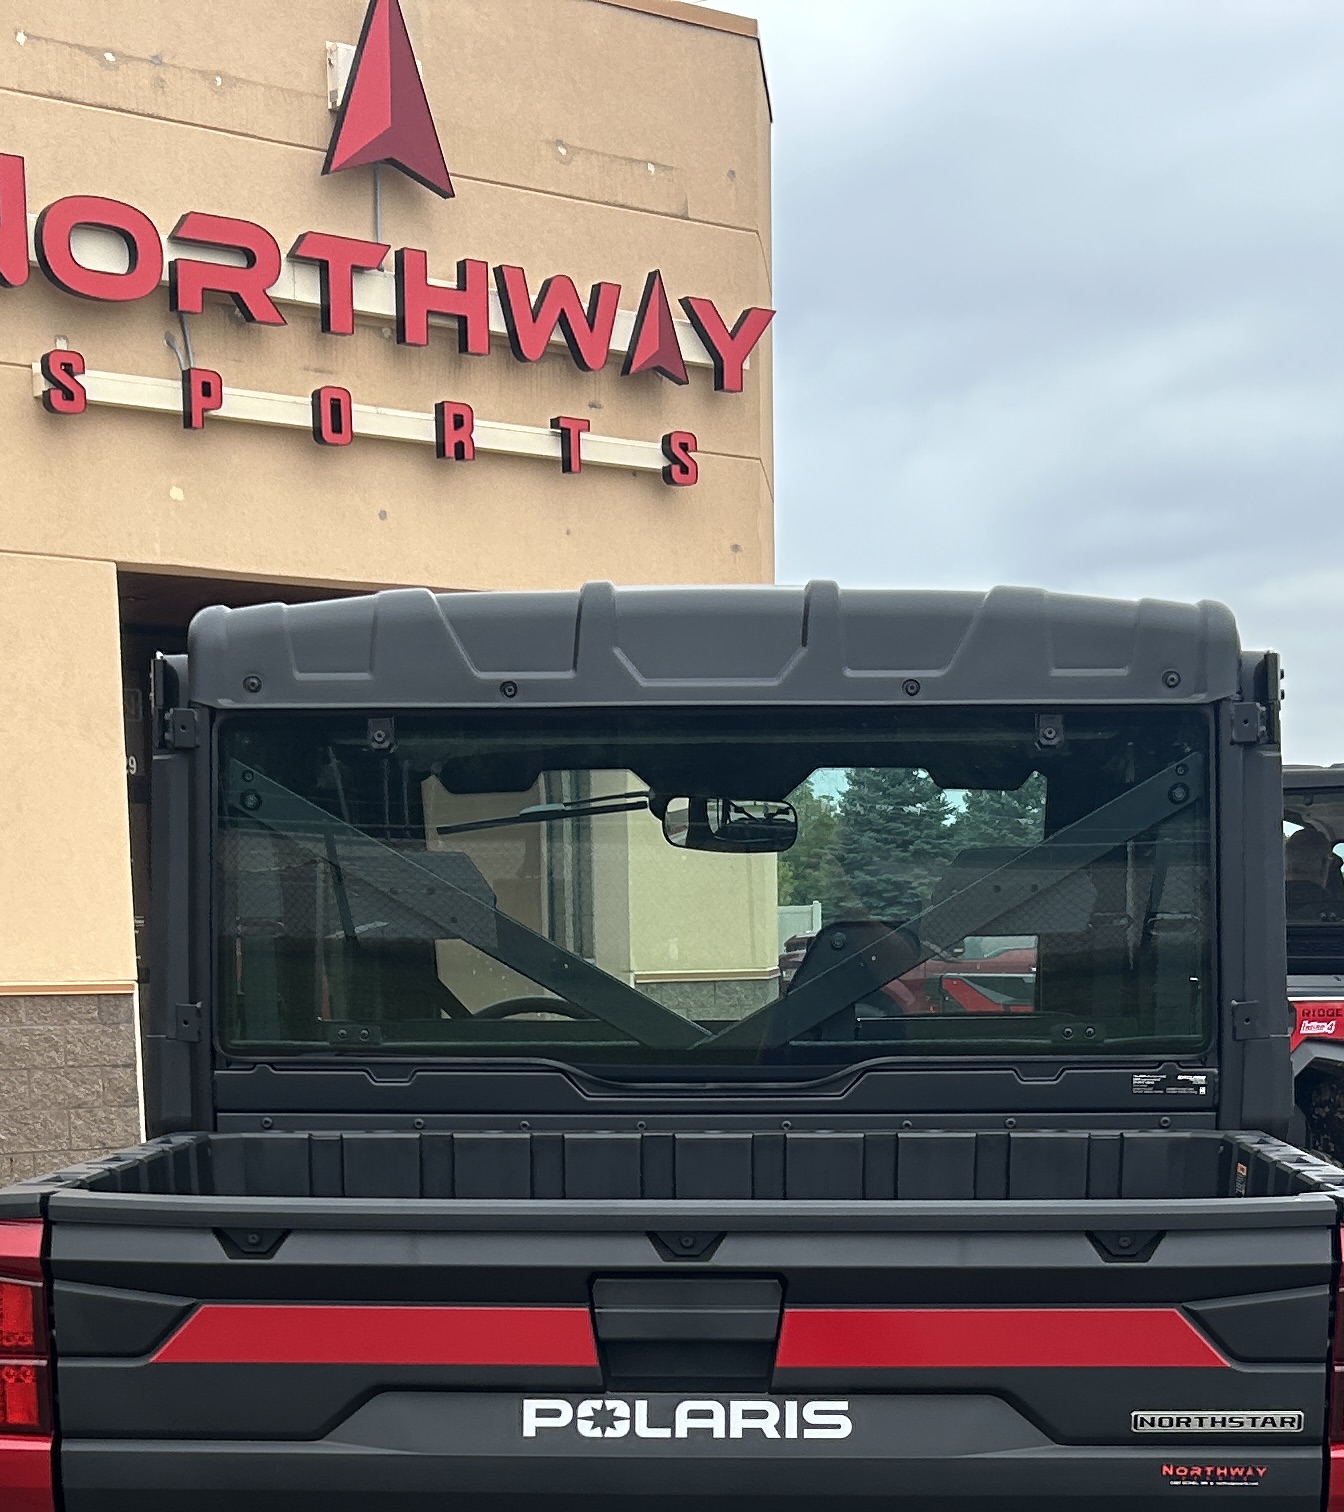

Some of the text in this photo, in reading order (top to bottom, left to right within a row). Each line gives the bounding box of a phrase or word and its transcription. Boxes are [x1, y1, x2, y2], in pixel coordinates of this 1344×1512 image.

[42, 350, 699, 487] SPORTS
[522, 1399, 853, 1439] POLARIS
[1139, 1416, 1296, 1428] NORTHSTAR
[1161, 1464, 1268, 1477] NORTHWAY
